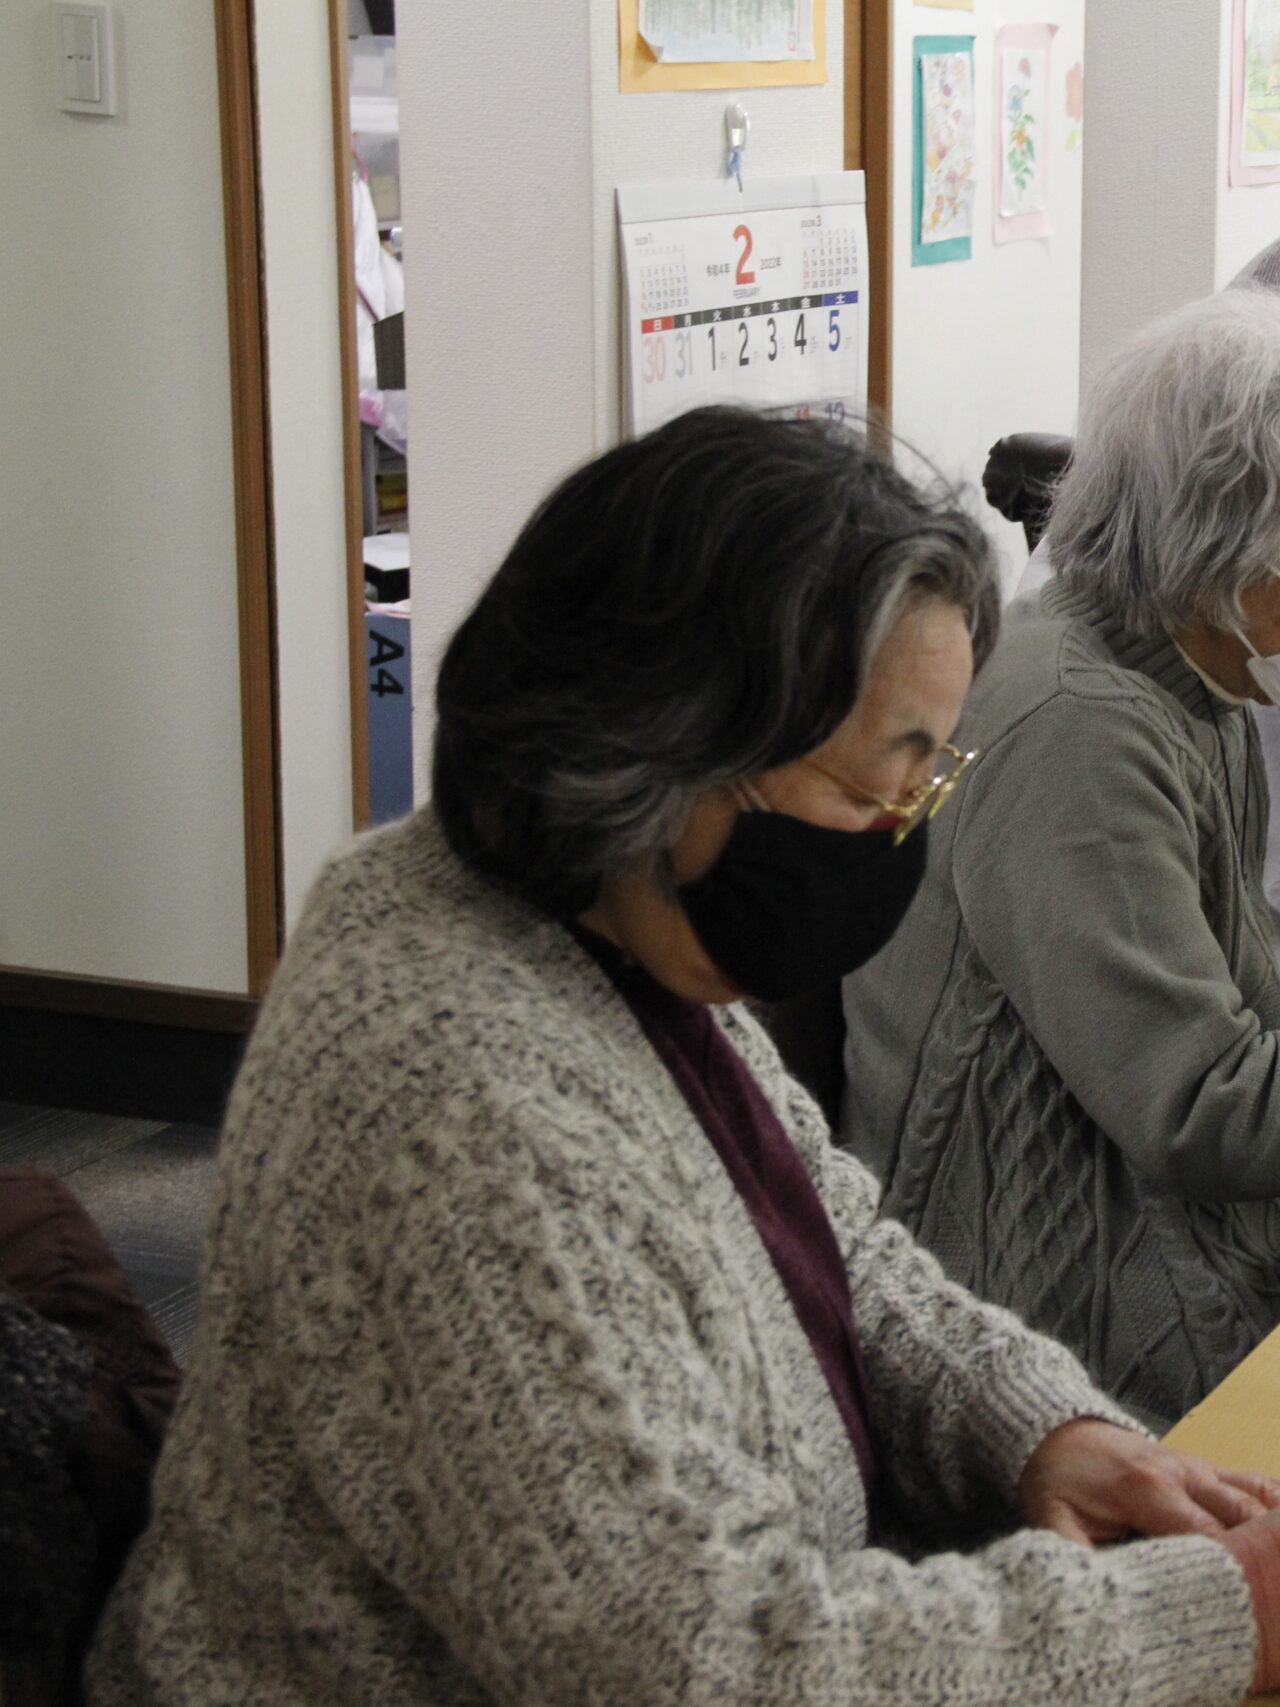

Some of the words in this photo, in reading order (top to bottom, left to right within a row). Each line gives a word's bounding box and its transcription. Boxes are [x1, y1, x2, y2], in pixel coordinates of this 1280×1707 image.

[732, 224, 756, 286] 2
[653, 320, 662, 331] 日
[800, 297, 811, 308] 金
[835, 293, 846, 305] 土
[642, 335, 667, 384] 30
[675, 331, 694, 379] 31
[708, 326, 716, 371] 1
[738, 321, 750, 366] 2
[767, 317, 777, 361] 3
[794, 313, 807, 355] 4
[829, 309, 841, 351] 5
[369, 630, 404, 698] A4
